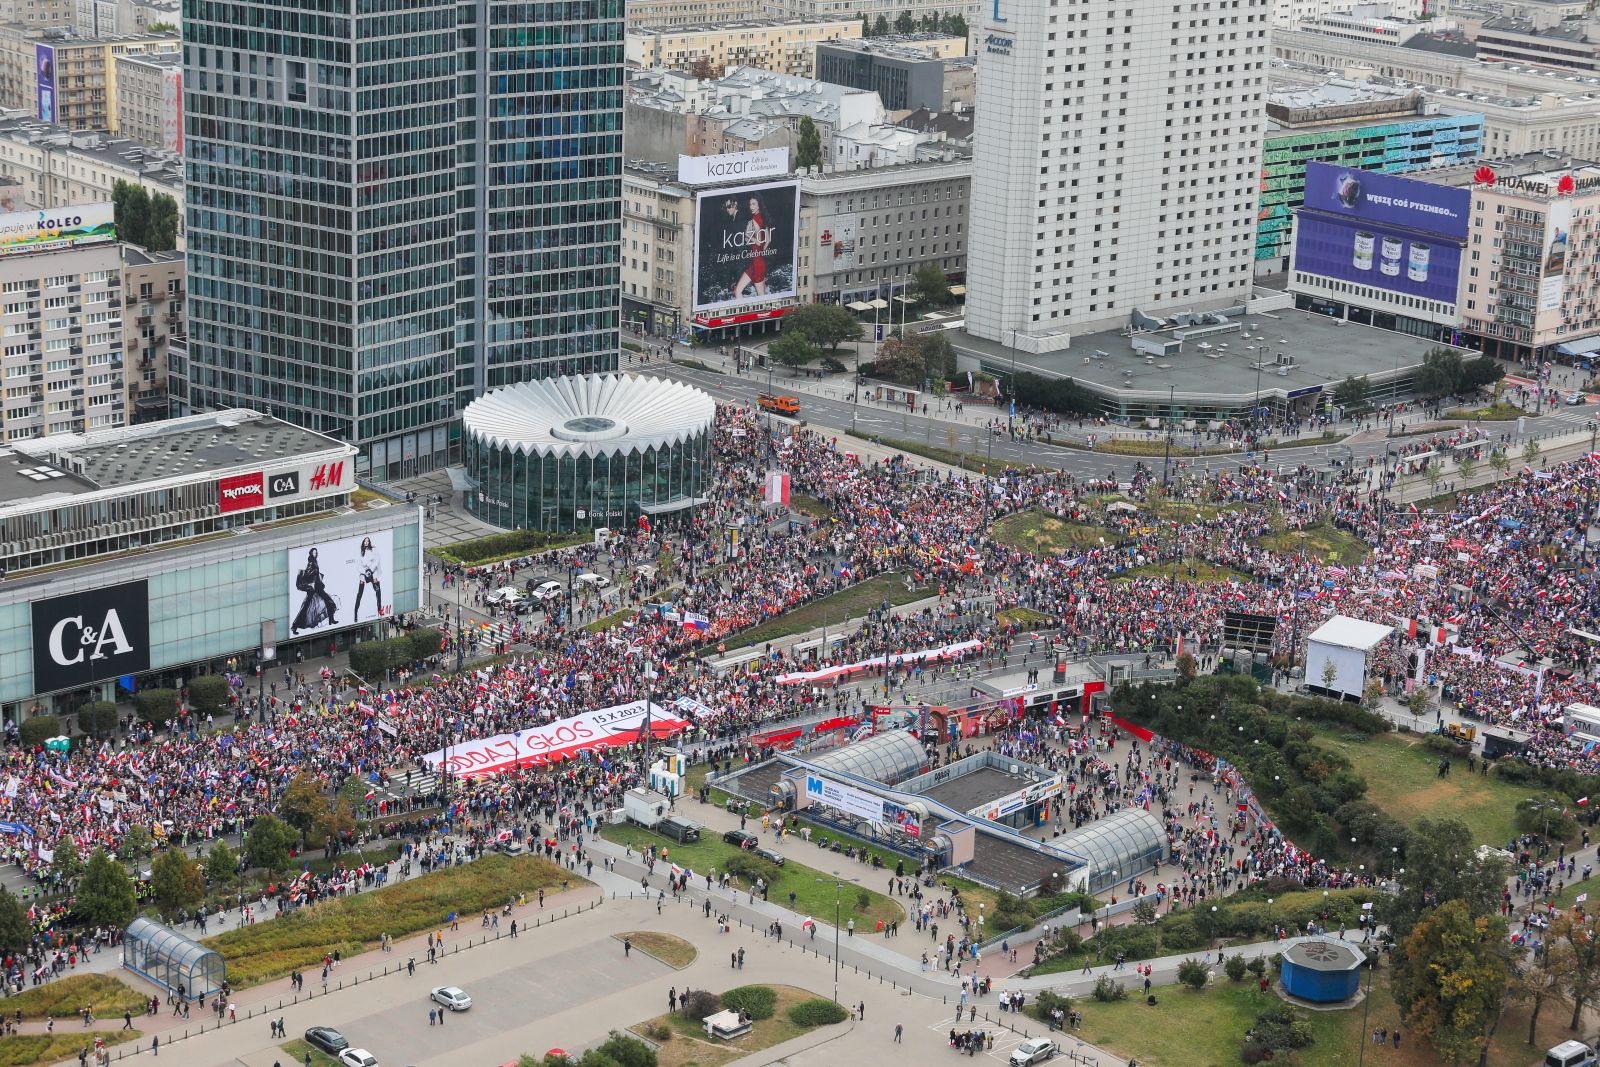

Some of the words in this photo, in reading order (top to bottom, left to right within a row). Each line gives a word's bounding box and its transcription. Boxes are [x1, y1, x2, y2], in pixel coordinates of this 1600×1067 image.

[707, 161, 749, 177] kazar
[1497, 176, 1549, 194] HUAWEI
[1366, 193, 1392, 206] WĘSZĘ
[1393, 198, 1408, 208] COŚ
[1409, 202, 1458, 218] PYSZNEGO...
[26, 223, 35, 231] w
[37, 216, 82, 230] KOLEO
[723, 227, 776, 249] kazar
[717, 253, 730, 264] Life
[741, 248, 778, 259] Celebration
[273, 477, 296, 492] C&A
[310, 461, 344, 490] H&M
[49, 608, 134, 666] C&A
[592, 714, 607, 724] 15
[620, 705, 646, 717] 2023
[527, 721, 594, 749] GŁOS
